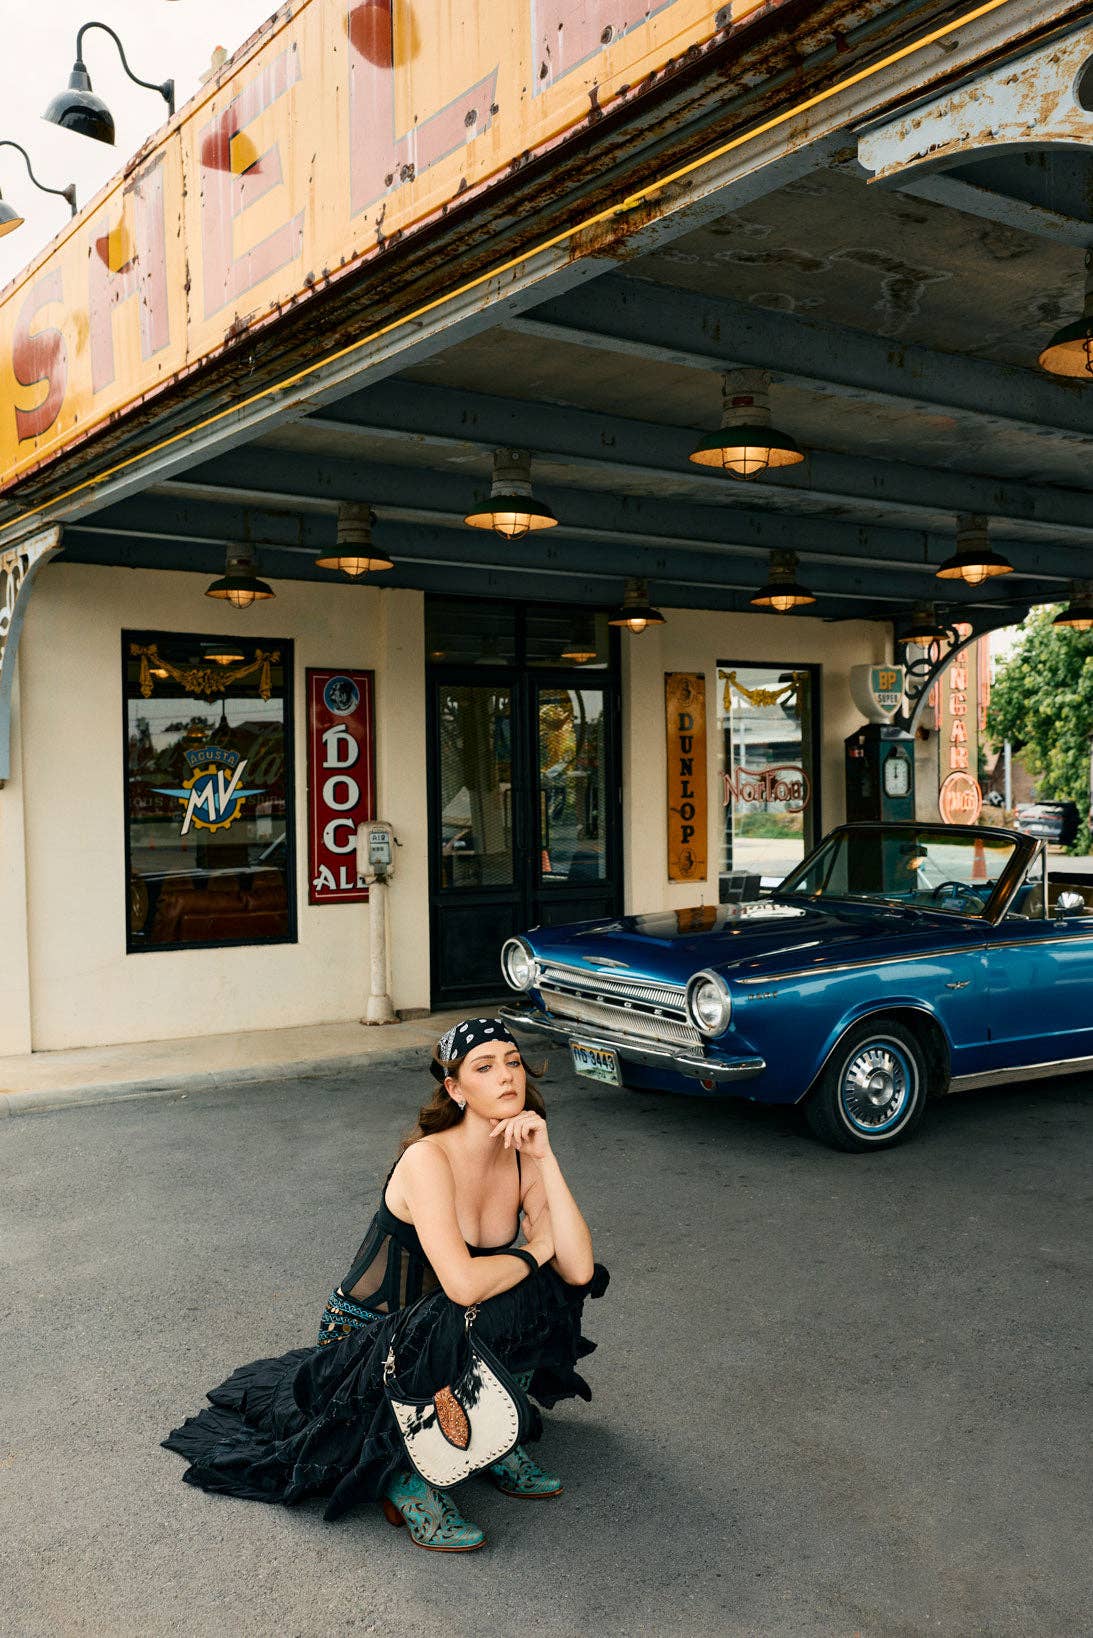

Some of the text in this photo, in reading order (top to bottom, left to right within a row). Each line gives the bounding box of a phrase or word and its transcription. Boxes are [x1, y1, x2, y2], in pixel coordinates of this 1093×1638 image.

[879, 671, 897, 690] BP
[190, 750, 235, 764] AGUSTA
[678, 712, 696, 844] DUNLOP
[180, 759, 248, 836] MV
[322, 723, 360, 854] DOG
[589, 1050, 615, 1071] 3443
